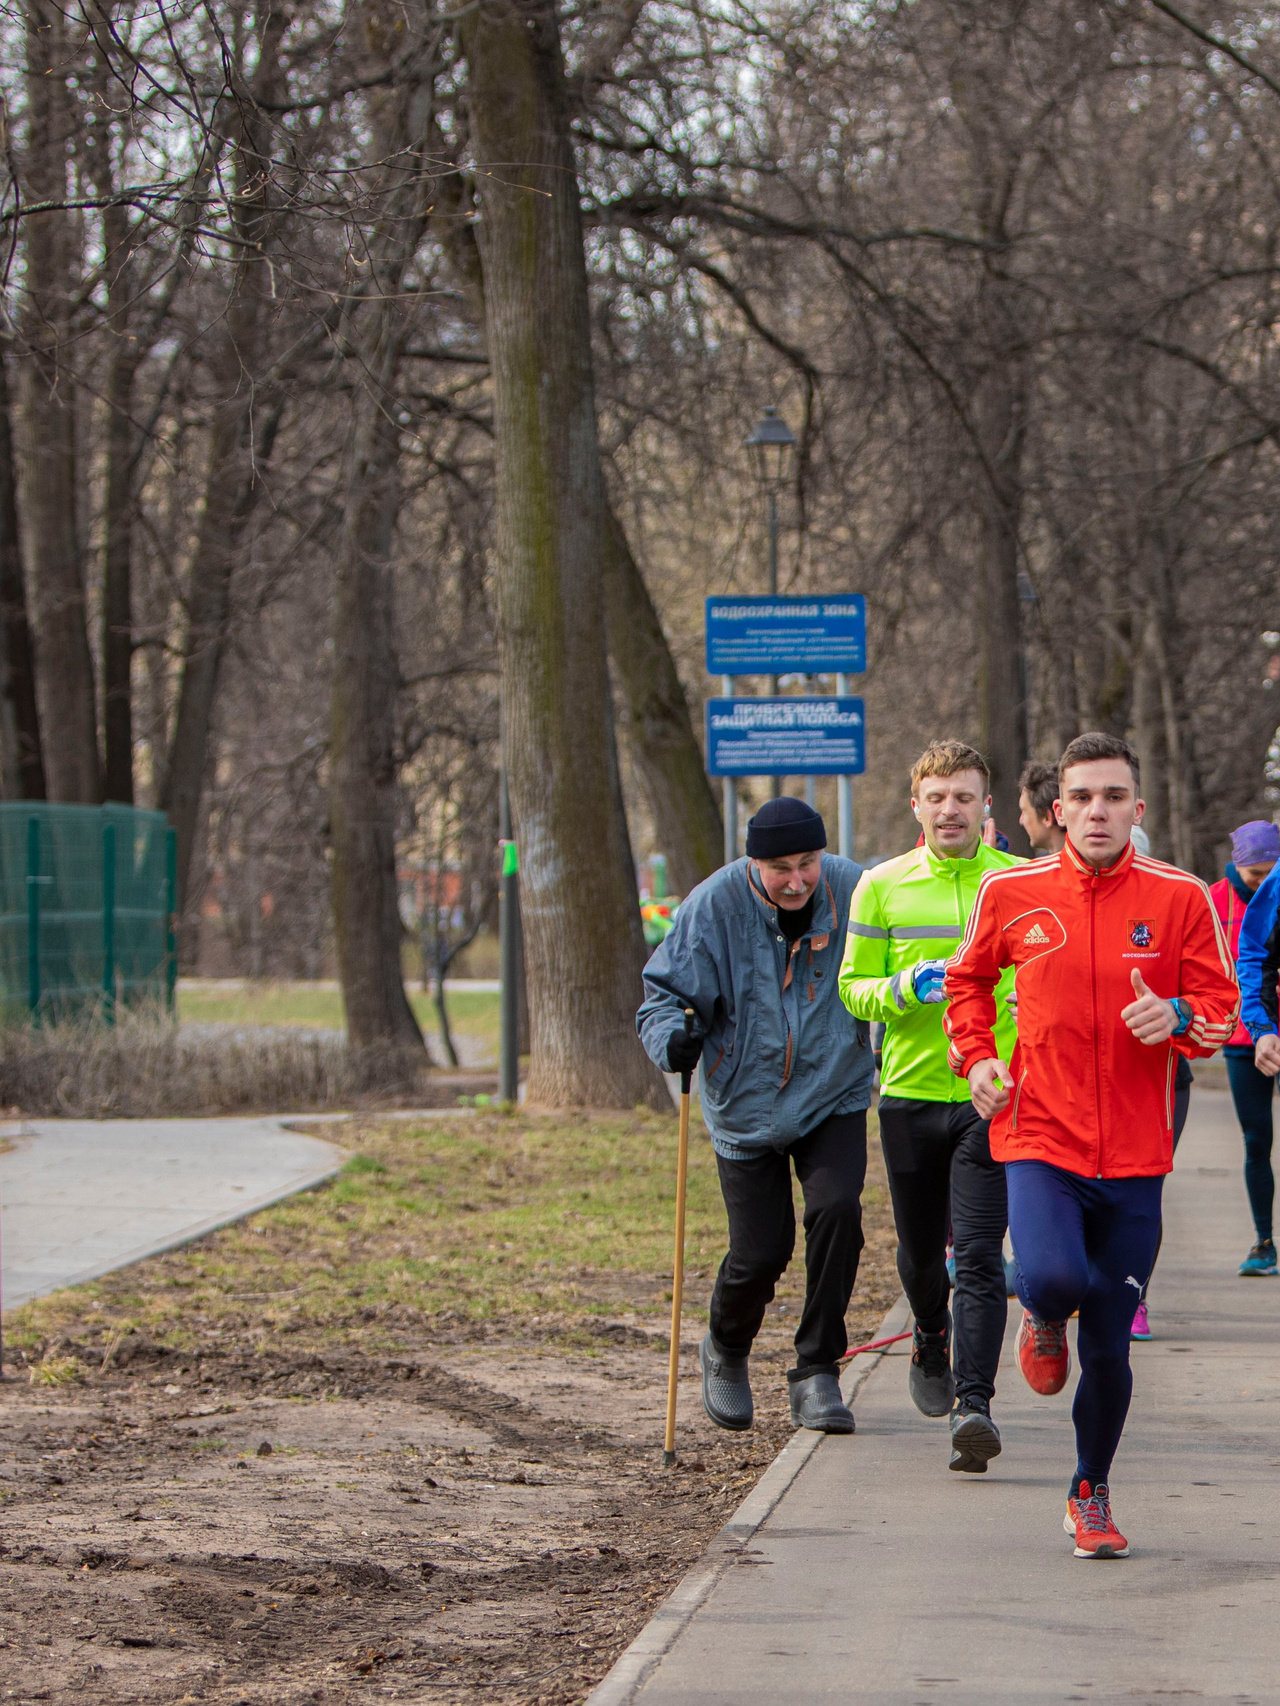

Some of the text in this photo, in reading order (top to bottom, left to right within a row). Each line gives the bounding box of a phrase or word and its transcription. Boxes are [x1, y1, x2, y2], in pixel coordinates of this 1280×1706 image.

[711, 604, 858, 619] ВОДООХРАННАЯ ЗОНА
[733, 702, 839, 714] ПРИБРЕЖНАЯ
[711, 712, 862, 729] ЗАЩИТНАЯ ПОЛОСА
[1023, 936, 1050, 944] adidas
